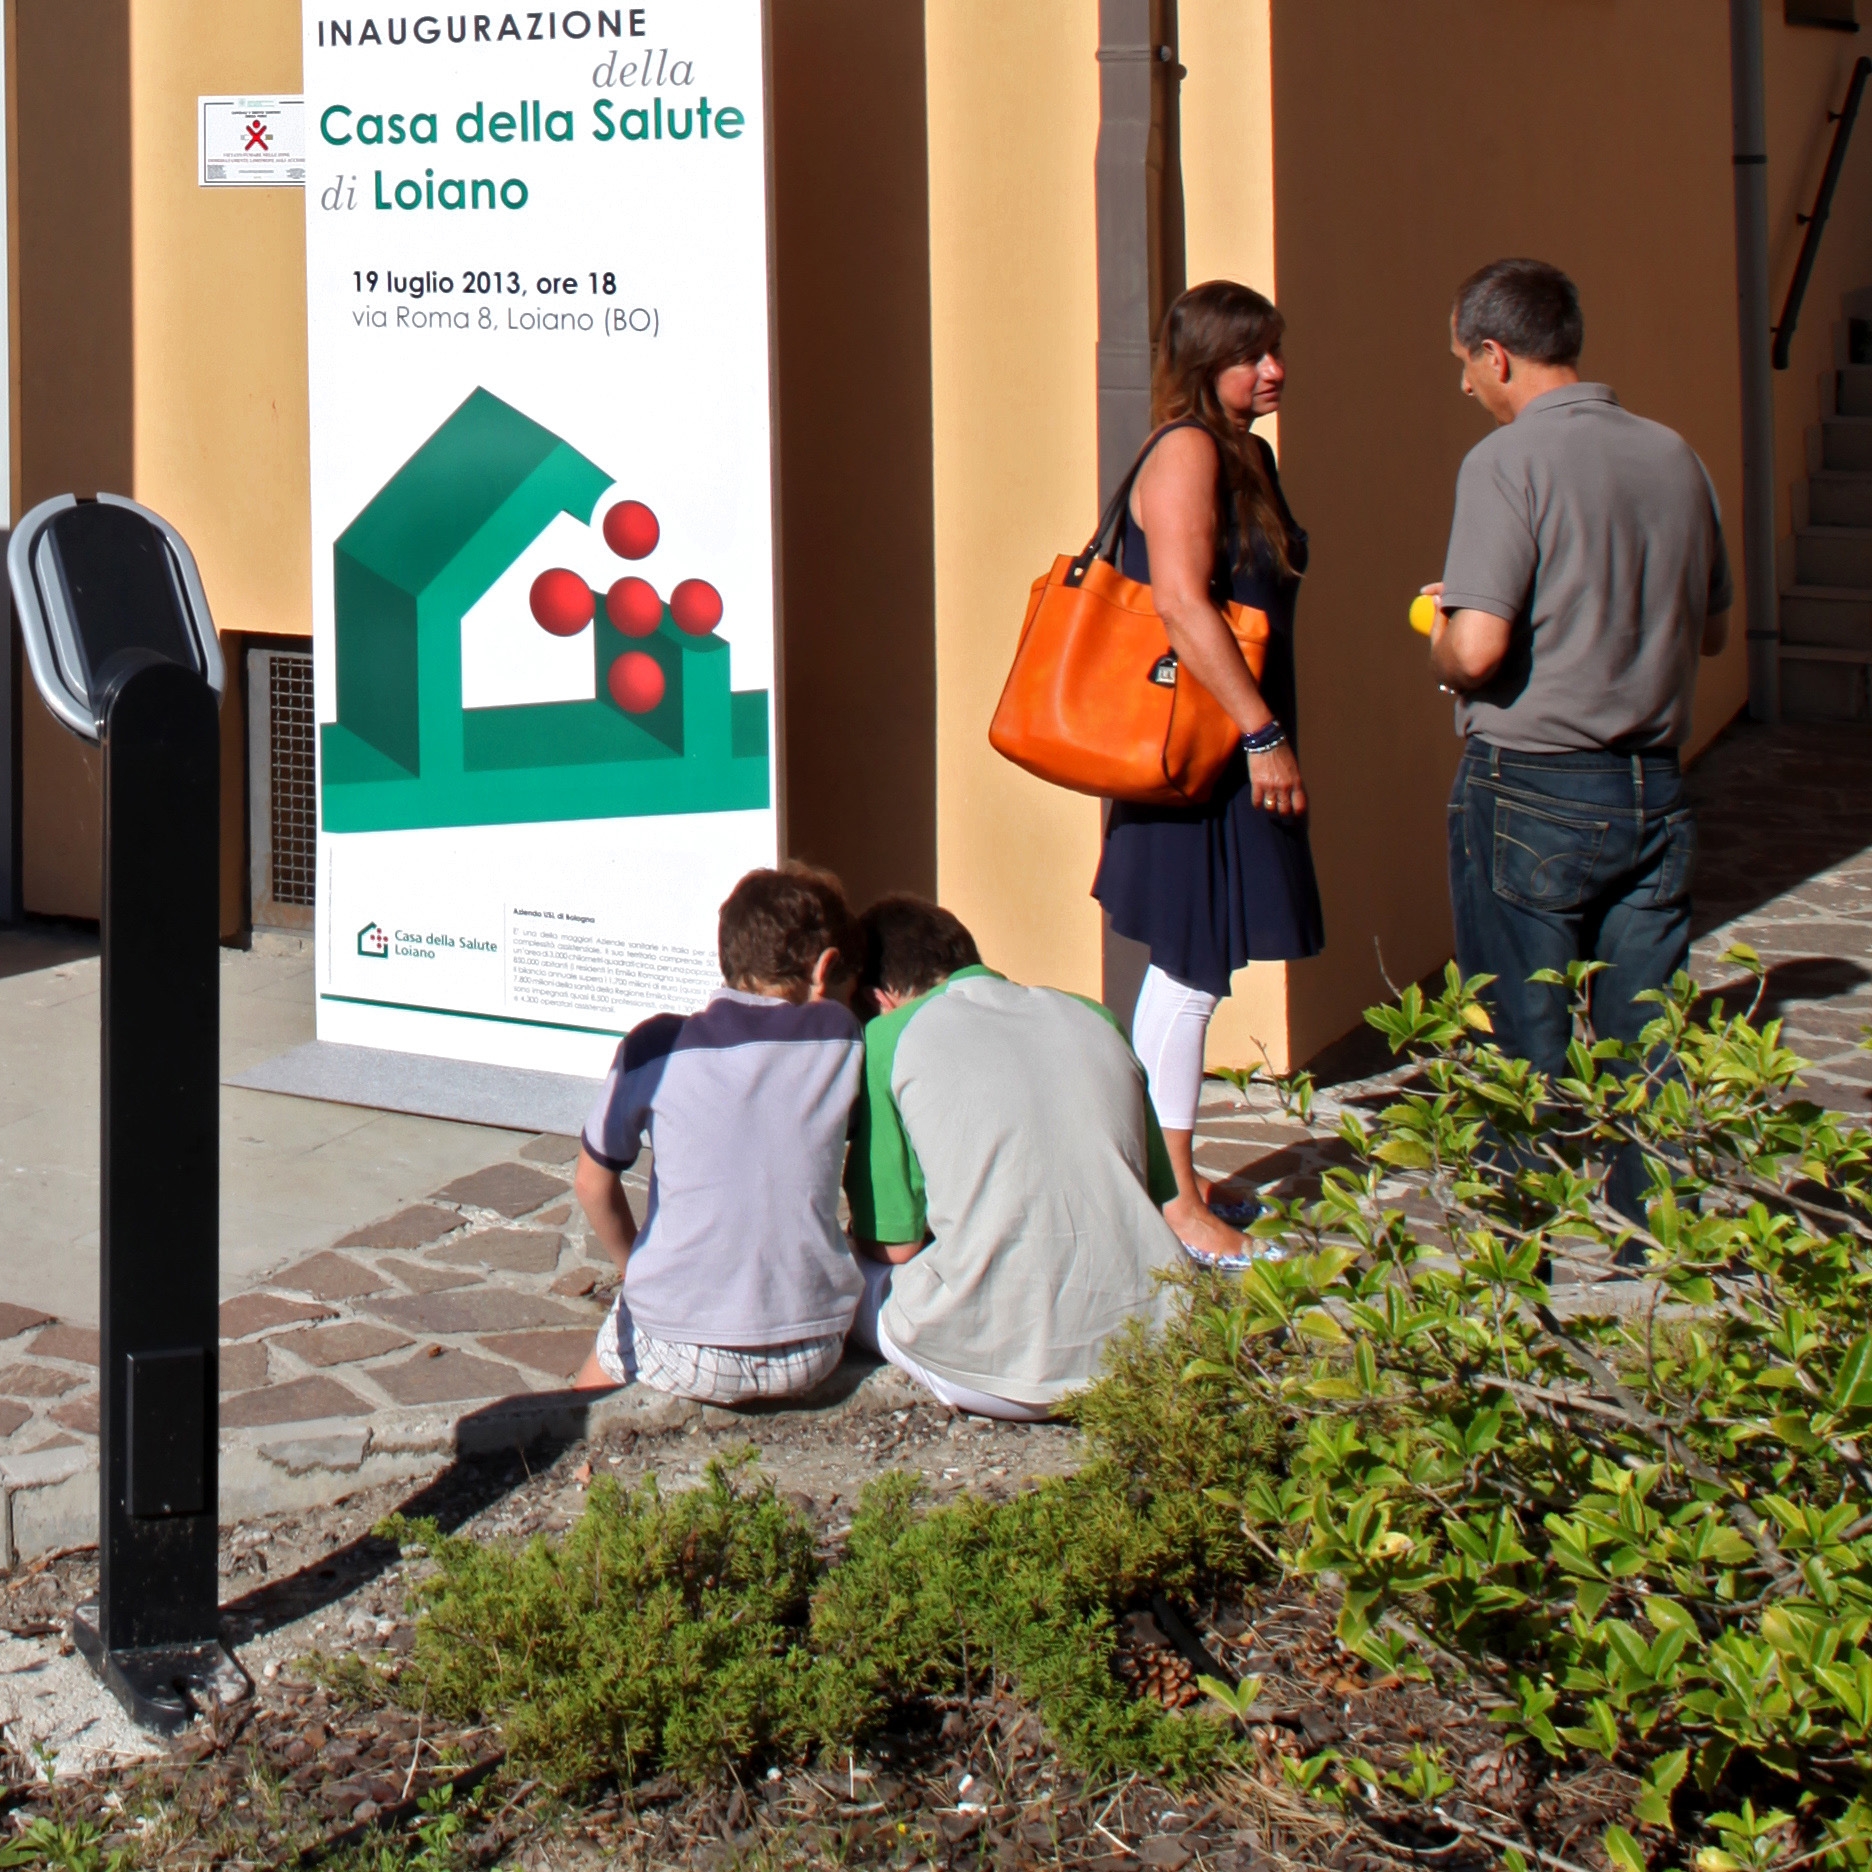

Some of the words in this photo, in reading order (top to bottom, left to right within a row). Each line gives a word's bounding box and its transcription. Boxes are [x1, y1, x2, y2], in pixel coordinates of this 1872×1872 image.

[319, 9, 645, 47] INAUGURAZIONE
[593, 49, 694, 88] della
[320, 105, 437, 145] Casa
[456, 100, 573, 143] della
[593, 97, 744, 141] Salute
[321, 175, 356, 210] di
[375, 168, 528, 210] Loiano
[354, 271, 378, 292] 19
[388, 271, 453, 298] luglio
[463, 271, 526, 296] 2013,
[537, 277, 578, 294] ore
[589, 272, 616, 295] 18
[353, 306, 386, 327] via
[397, 306, 469, 329] Roma
[478, 307, 497, 330] 8,
[508, 307, 593, 331] Loiano
[605, 308, 659, 337] (BO)
[566, 913, 595, 923] Bologna
[395, 930, 422, 943] Casa
[426, 933, 455, 947] della
[459, 937, 497, 952] Salute
[395, 943, 435, 959] Loiano
